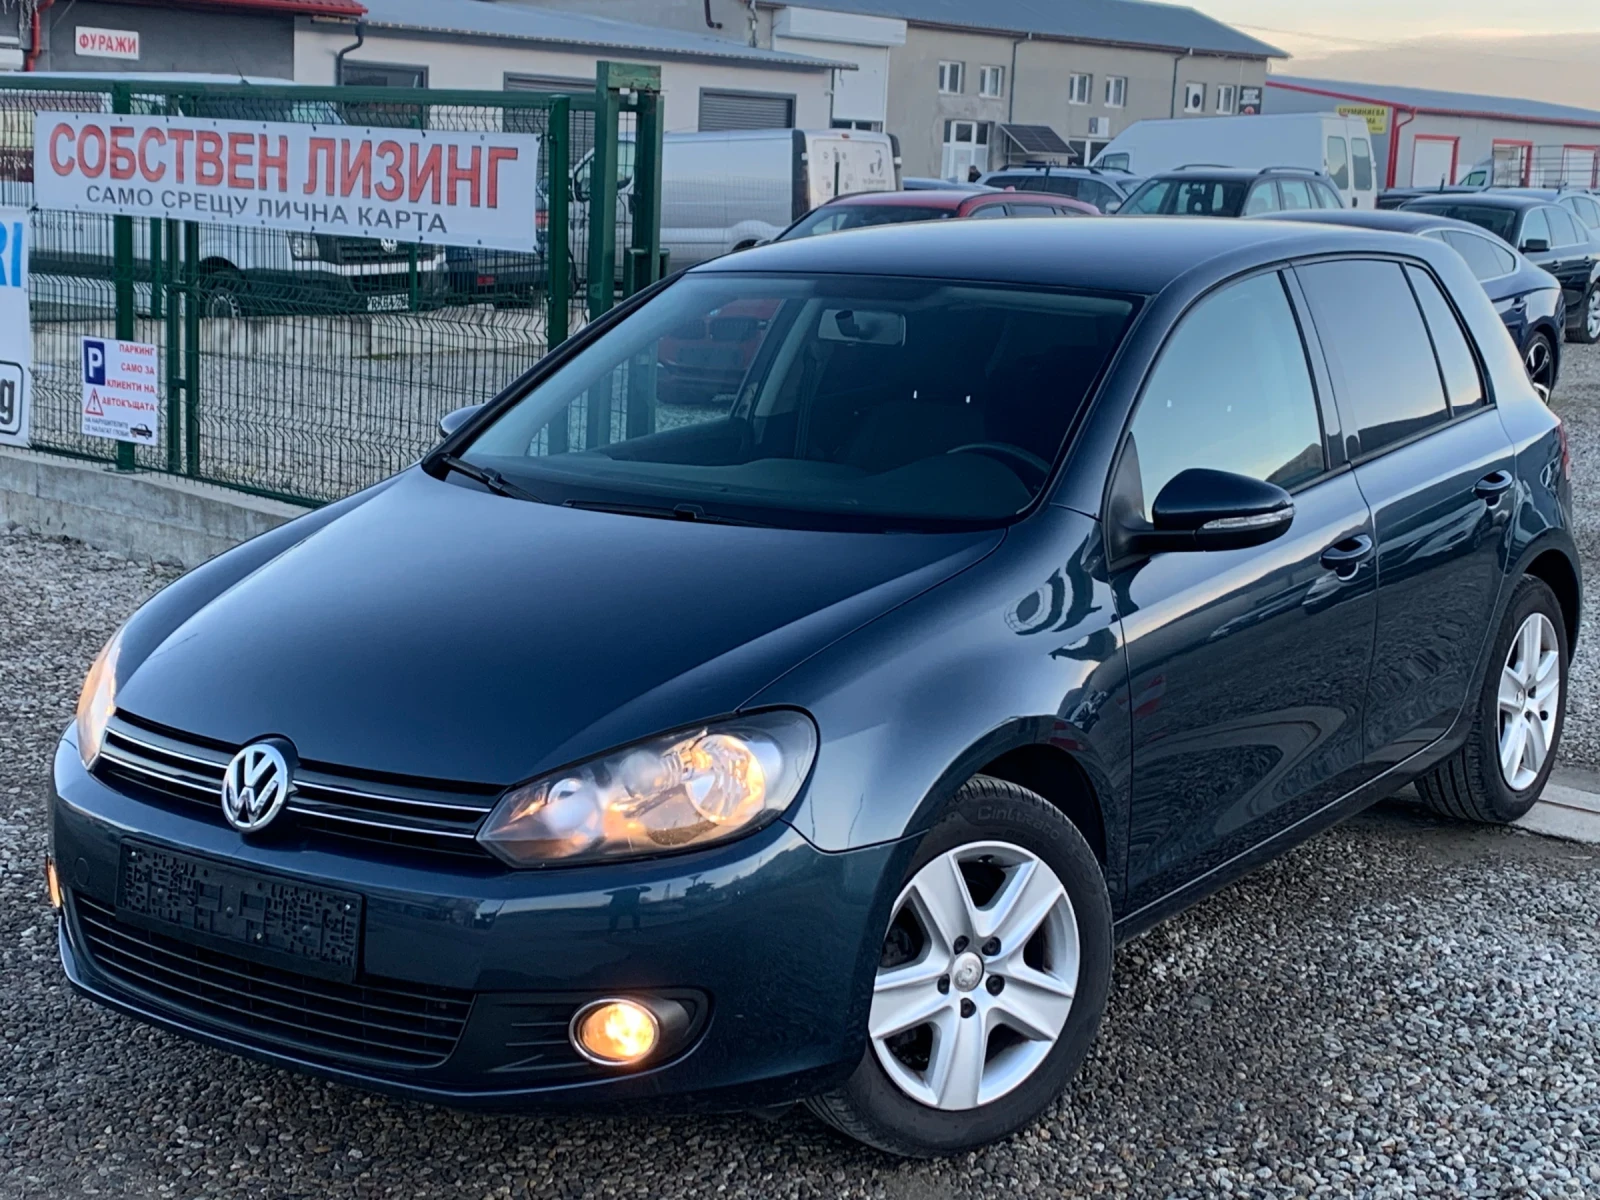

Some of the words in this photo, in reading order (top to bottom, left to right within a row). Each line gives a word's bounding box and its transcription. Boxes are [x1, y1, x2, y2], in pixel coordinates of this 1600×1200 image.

[79, 33, 136, 53] ФУРАЖИ
[49, 122, 288, 192] СОБСТВЕН
[303, 136, 518, 208] ЛИЗИНГ
[87, 185, 153, 206] САМО
[161, 190, 248, 217] СРЕЩУ
[256, 198, 348, 224] ЛИЧНА
[358, 206, 447, 233] КАРТА
[119, 344, 155, 356] ПАРКИНГ
[121, 363, 143, 373] САМО
[145, 367, 155, 375] ЗА
[106, 379, 142, 391] КЛИЕНТИ
[144, 384, 155, 393] НА
[102, 396, 155, 412] АВТОКЪЩАТА
